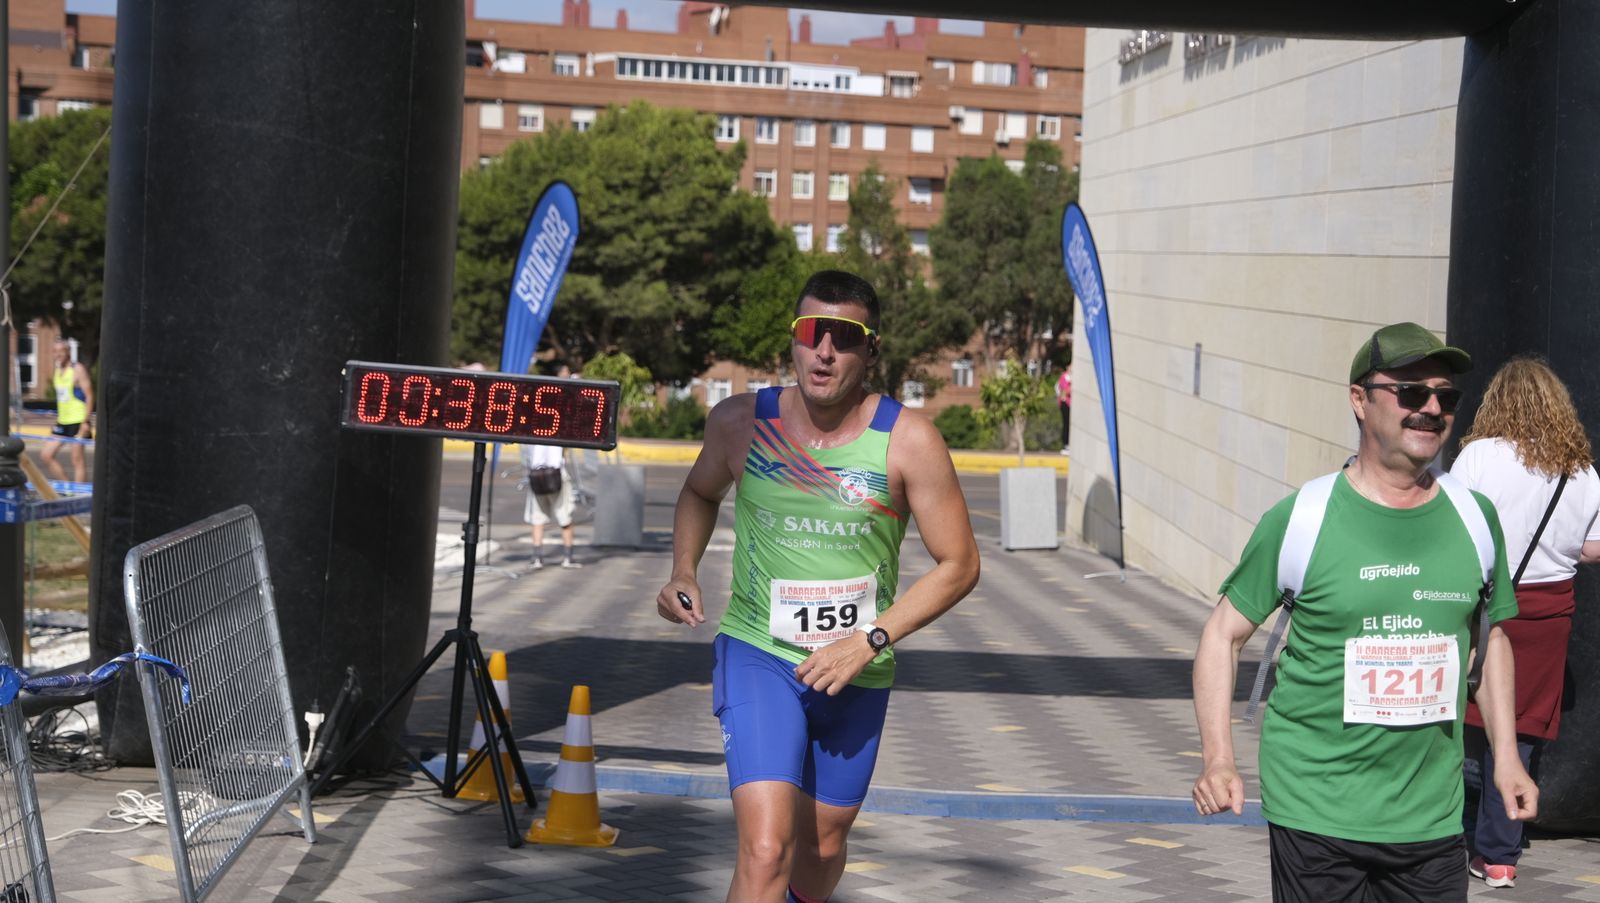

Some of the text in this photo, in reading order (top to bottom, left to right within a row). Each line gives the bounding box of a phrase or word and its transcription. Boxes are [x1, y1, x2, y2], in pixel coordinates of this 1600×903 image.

[357, 372, 605, 437] 00:38:57
[783, 516, 871, 536] SAKATA
[775, 537, 861, 550] PASSION in Seed
[793, 603, 858, 632] 159
[1362, 614, 1423, 632] El Ejido
[1365, 645, 1408, 655] CARRERA
[1410, 645, 1425, 655] SIN
[1360, 667, 1444, 696] 1211
